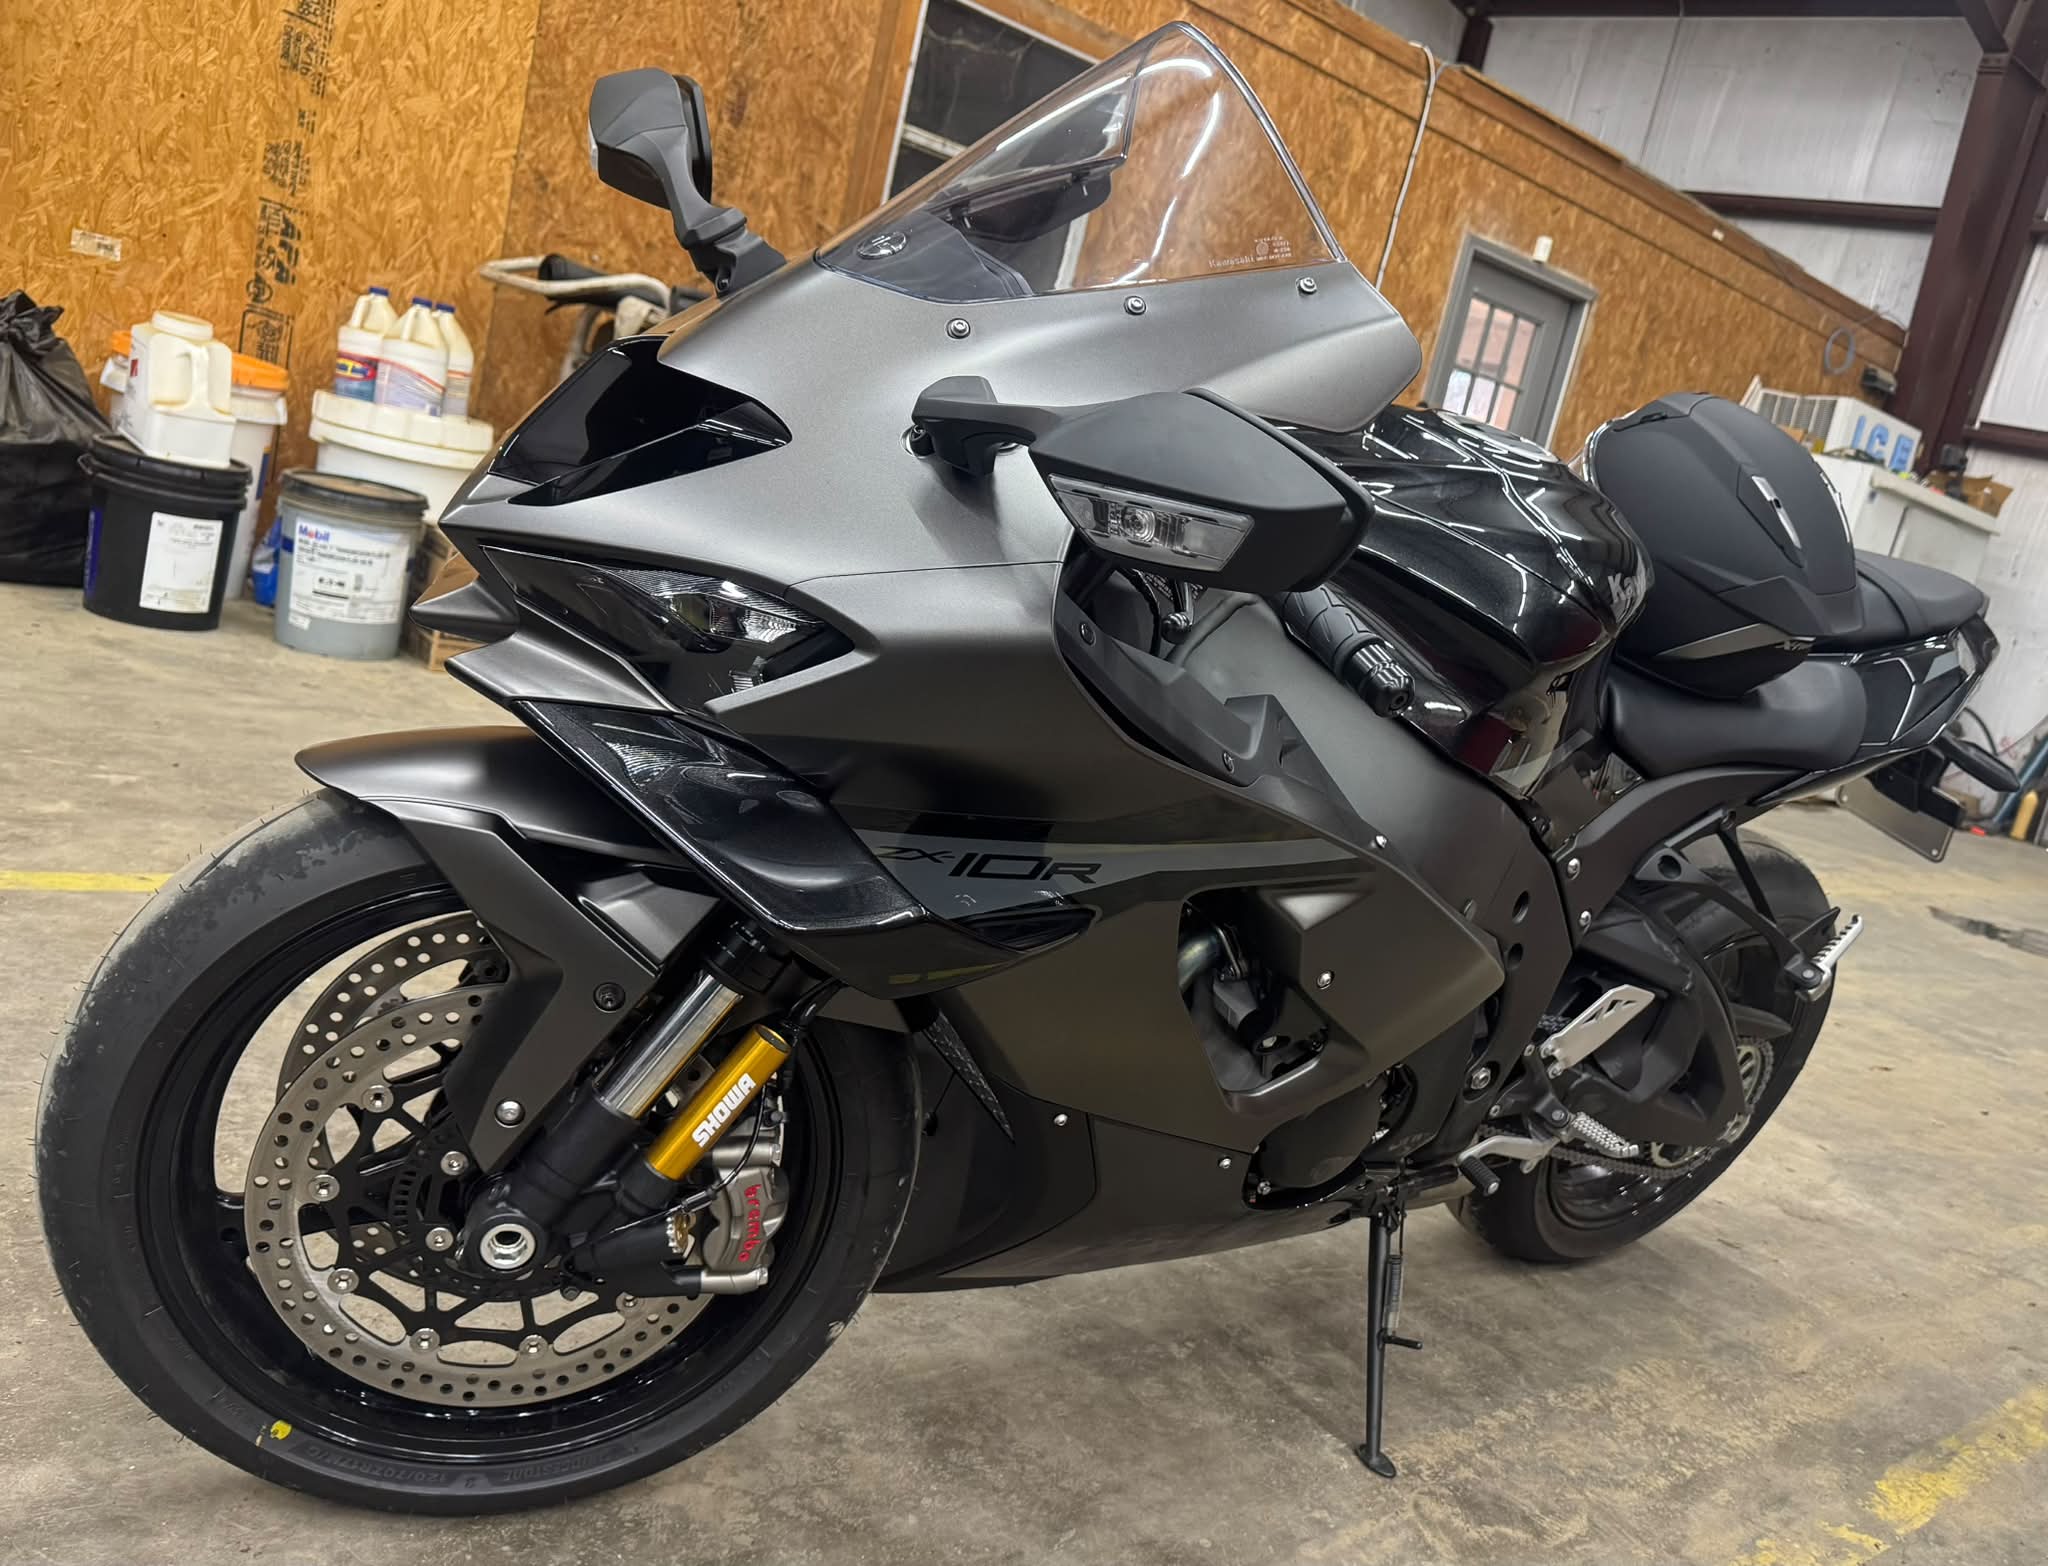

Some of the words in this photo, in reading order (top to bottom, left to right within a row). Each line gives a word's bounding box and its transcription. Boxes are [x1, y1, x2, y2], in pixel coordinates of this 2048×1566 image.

[1851, 415, 1914, 471] ICE
[298, 524, 330, 542] Mobil
[874, 846, 1101, 884] ZX-10R
[692, 1072, 757, 1148] SHOWA
[738, 1184, 762, 1262] brembo
